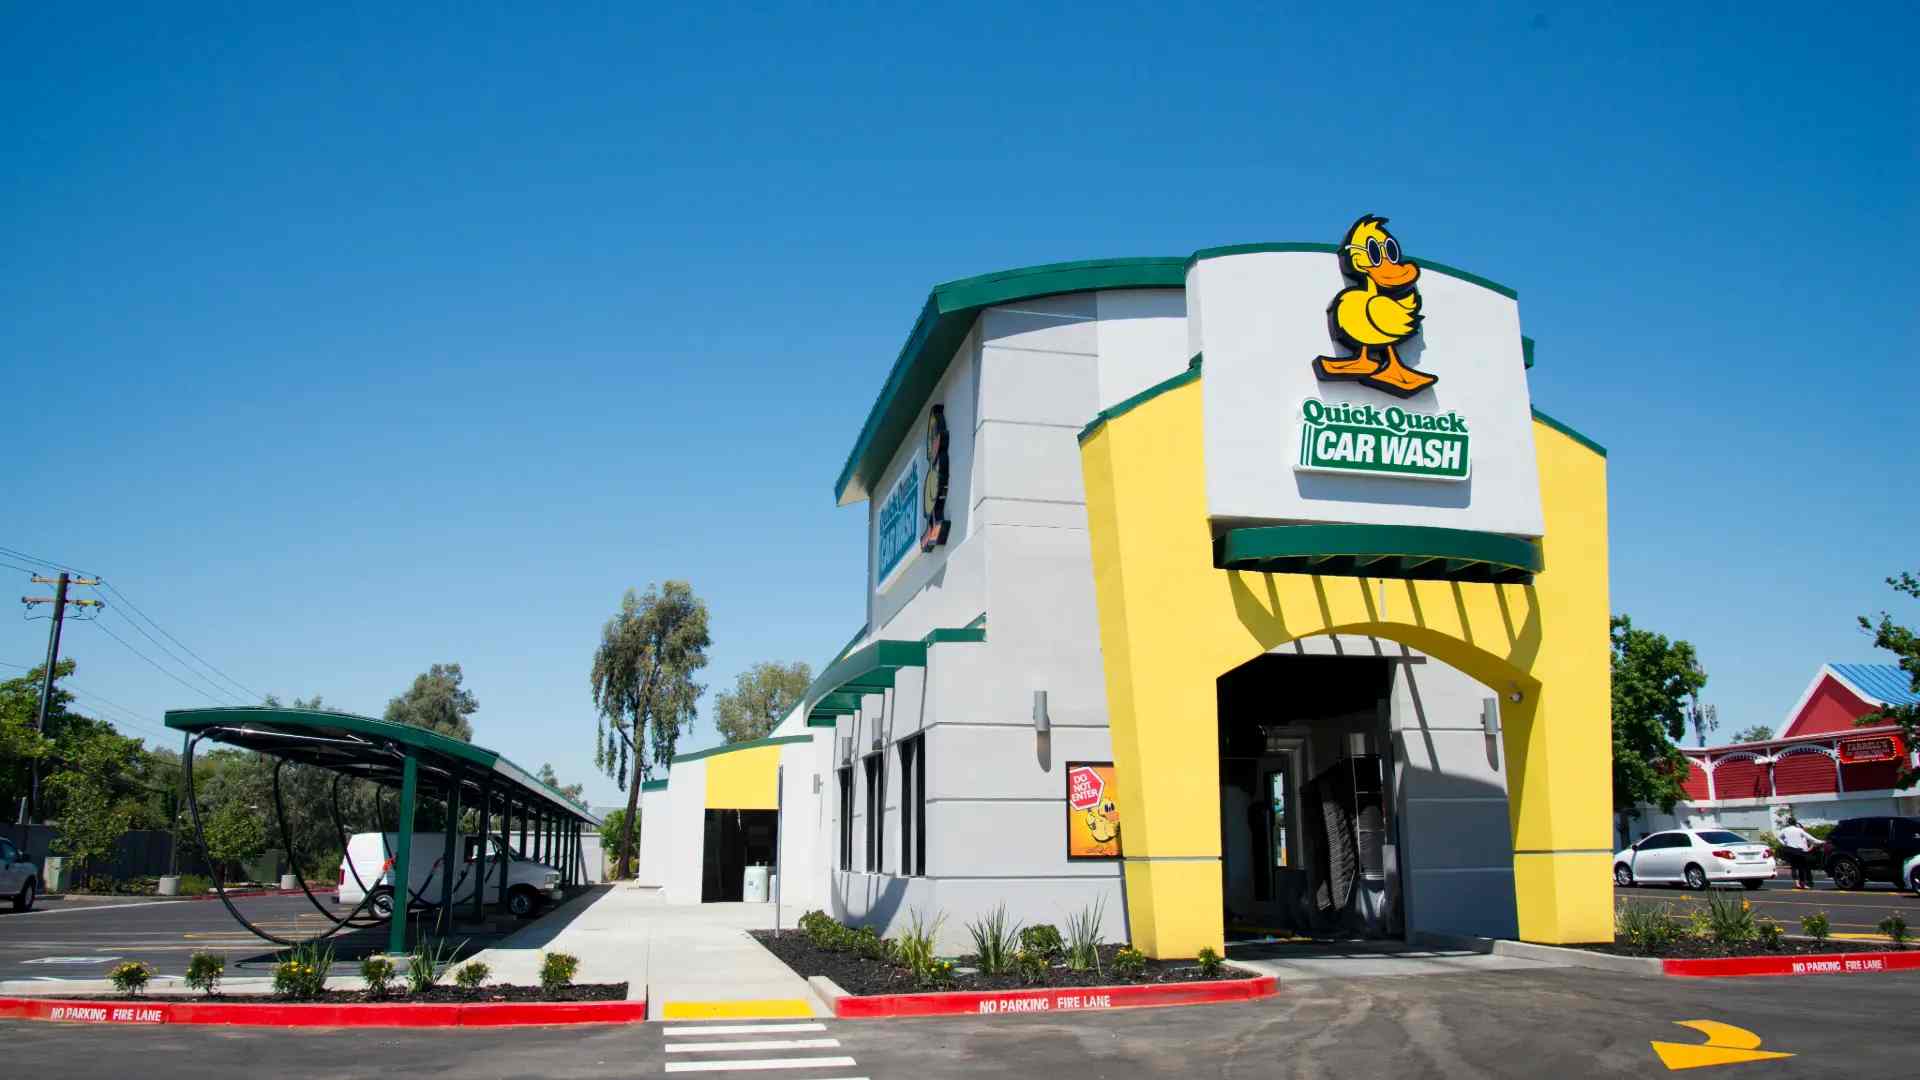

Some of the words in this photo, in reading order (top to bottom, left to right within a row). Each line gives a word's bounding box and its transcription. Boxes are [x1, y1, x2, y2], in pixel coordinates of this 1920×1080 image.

[1303, 399, 1384, 426] Quick
[1385, 407, 1468, 432] Quack
[1316, 430, 1376, 463] CAR
[1380, 435, 1462, 470] WASH
[1073, 775, 1088, 784] DO
[1073, 781, 1091, 793] NOT
[1072, 789, 1098, 801] ENTER
[1792, 962, 1805, 973] NO
[1806, 961, 1840, 971] PARKING
[1845, 960, 1862, 970] FIRE
[1863, 960, 1883, 969] LANE
[979, 1000, 997, 1014] NO
[1000, 998, 1049, 1013] PARKING
[1057, 996, 1080, 1009] FIRE
[1083, 995, 1111, 1007] LANE
[50, 1007, 64, 1020] NO
[65, 1007, 107, 1020] PARKING
[112, 1008, 134, 1020] FIRE
[135, 1009, 162, 1021] LANE
